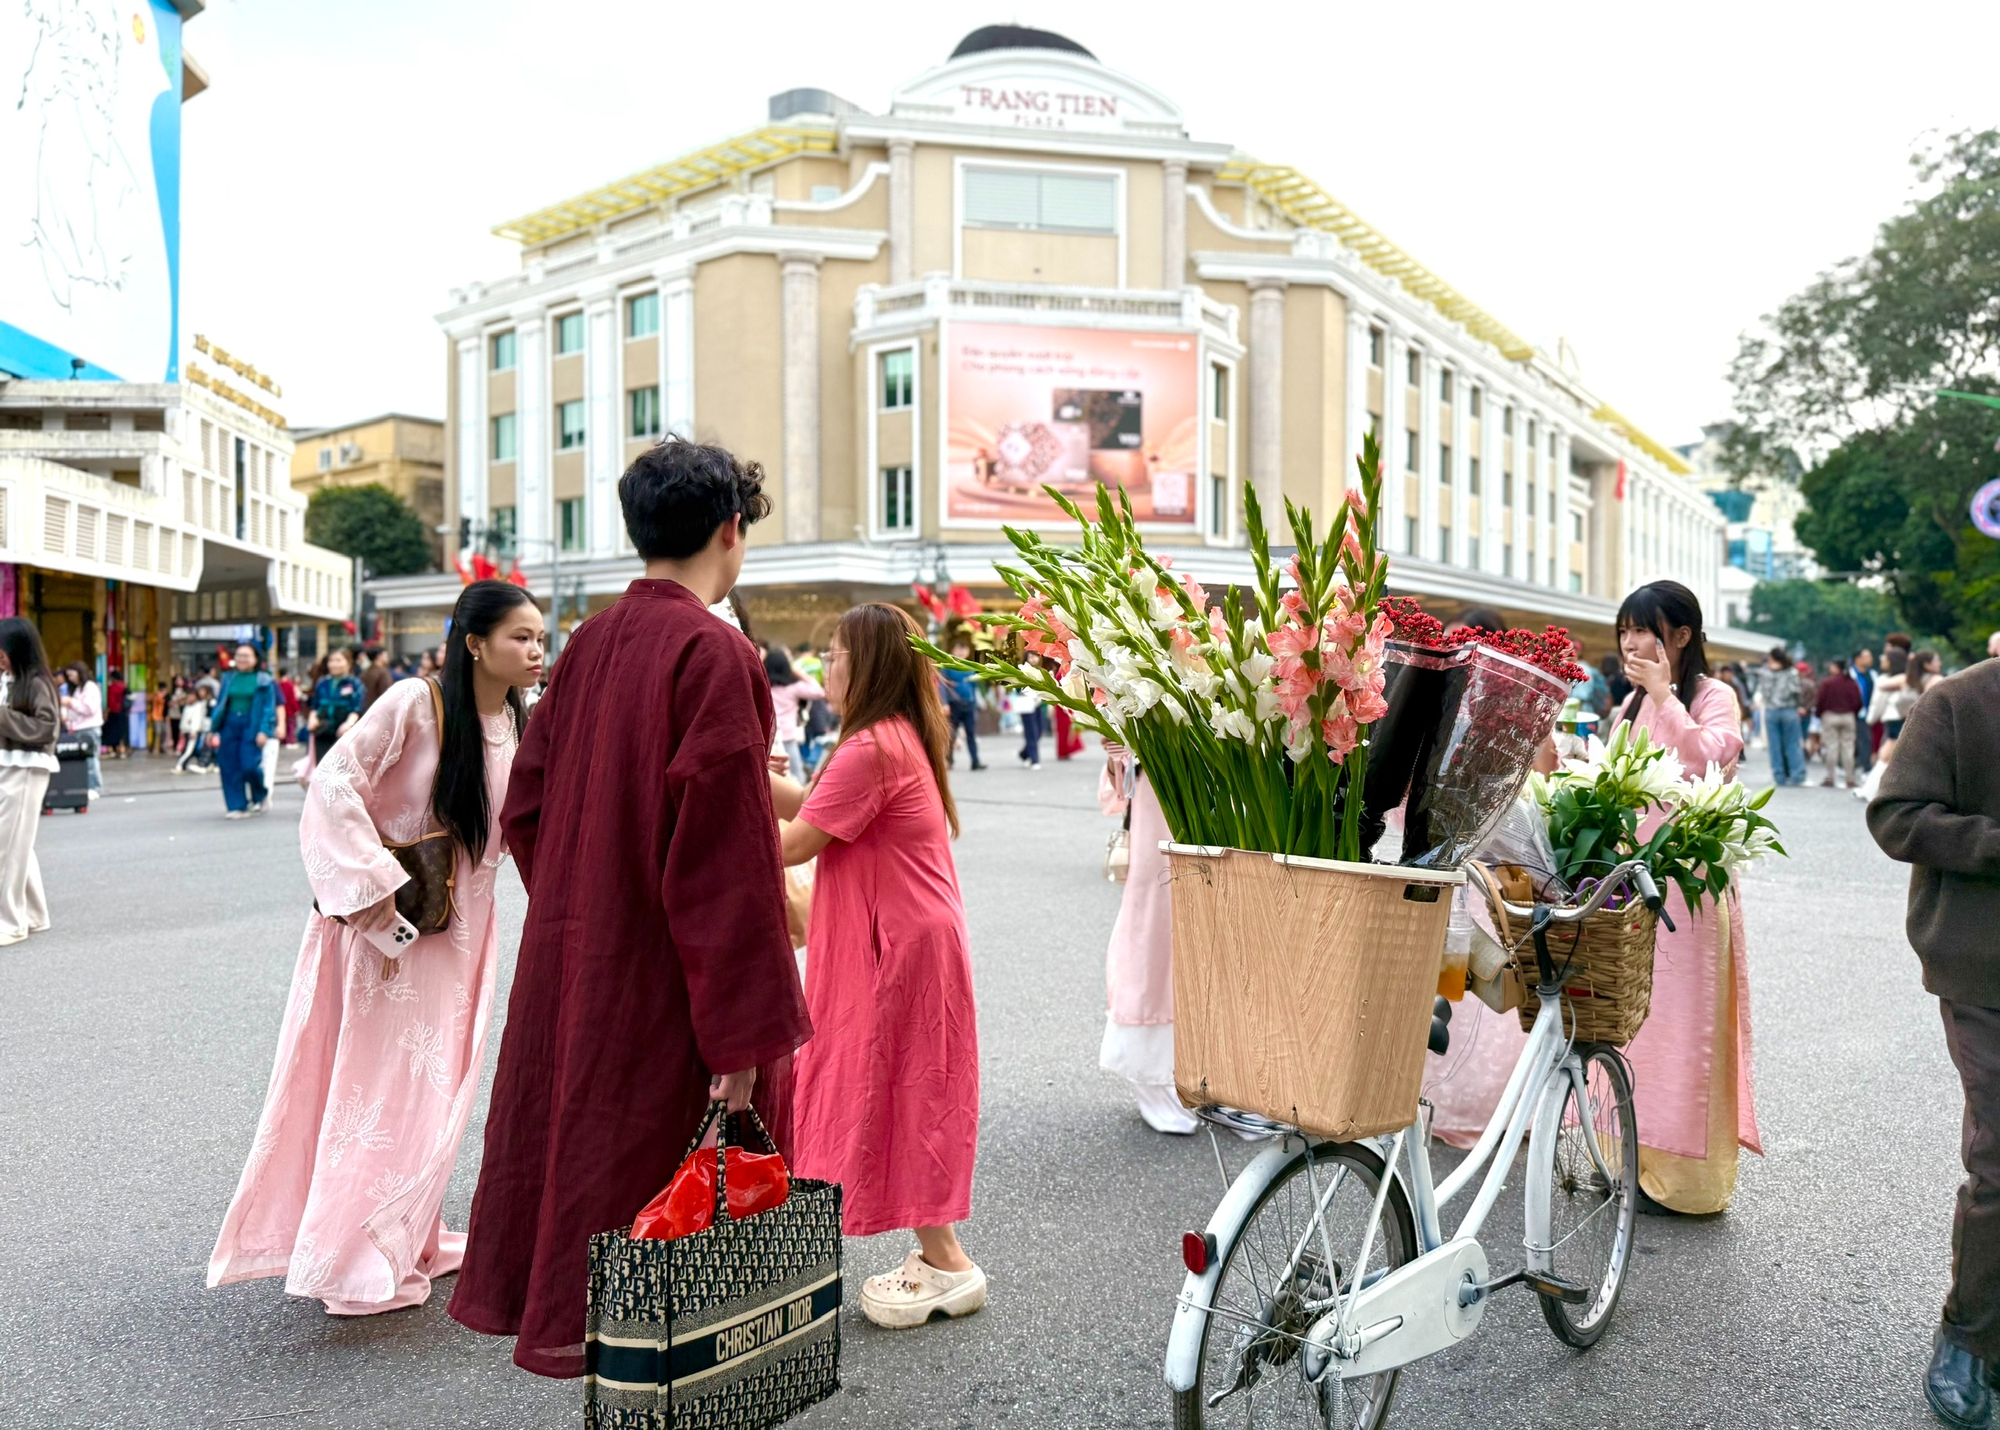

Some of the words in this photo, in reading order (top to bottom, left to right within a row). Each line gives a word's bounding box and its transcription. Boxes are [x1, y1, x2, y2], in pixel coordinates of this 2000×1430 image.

[960, 85, 1049, 112] TRANG
[1056, 93, 1118, 117] TIEN
[716, 1308, 783, 1362] CHRISTIAN
[788, 1296, 813, 1332] DIOR
